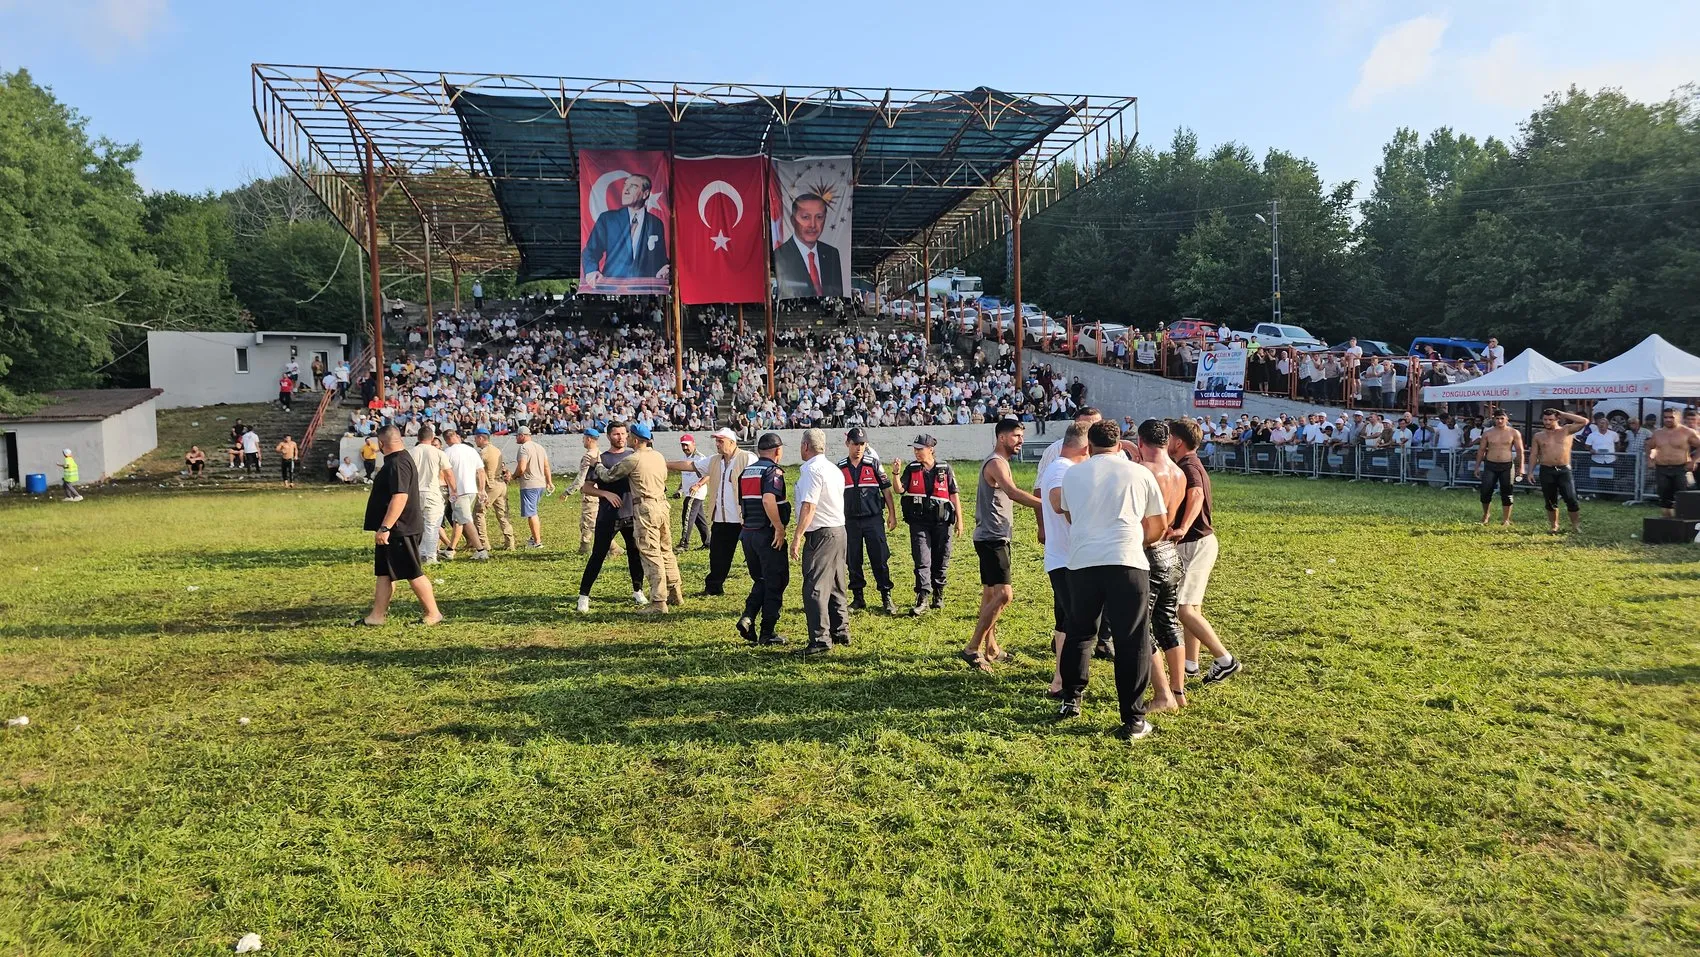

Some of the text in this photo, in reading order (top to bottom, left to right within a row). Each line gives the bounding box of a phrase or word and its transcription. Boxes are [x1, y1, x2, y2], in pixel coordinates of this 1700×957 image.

[1442, 387, 1509, 398] ZONGULDAK VALİLİĞİ
[1552, 384, 1637, 395] ZONGULDAK VALİLİĞİ
